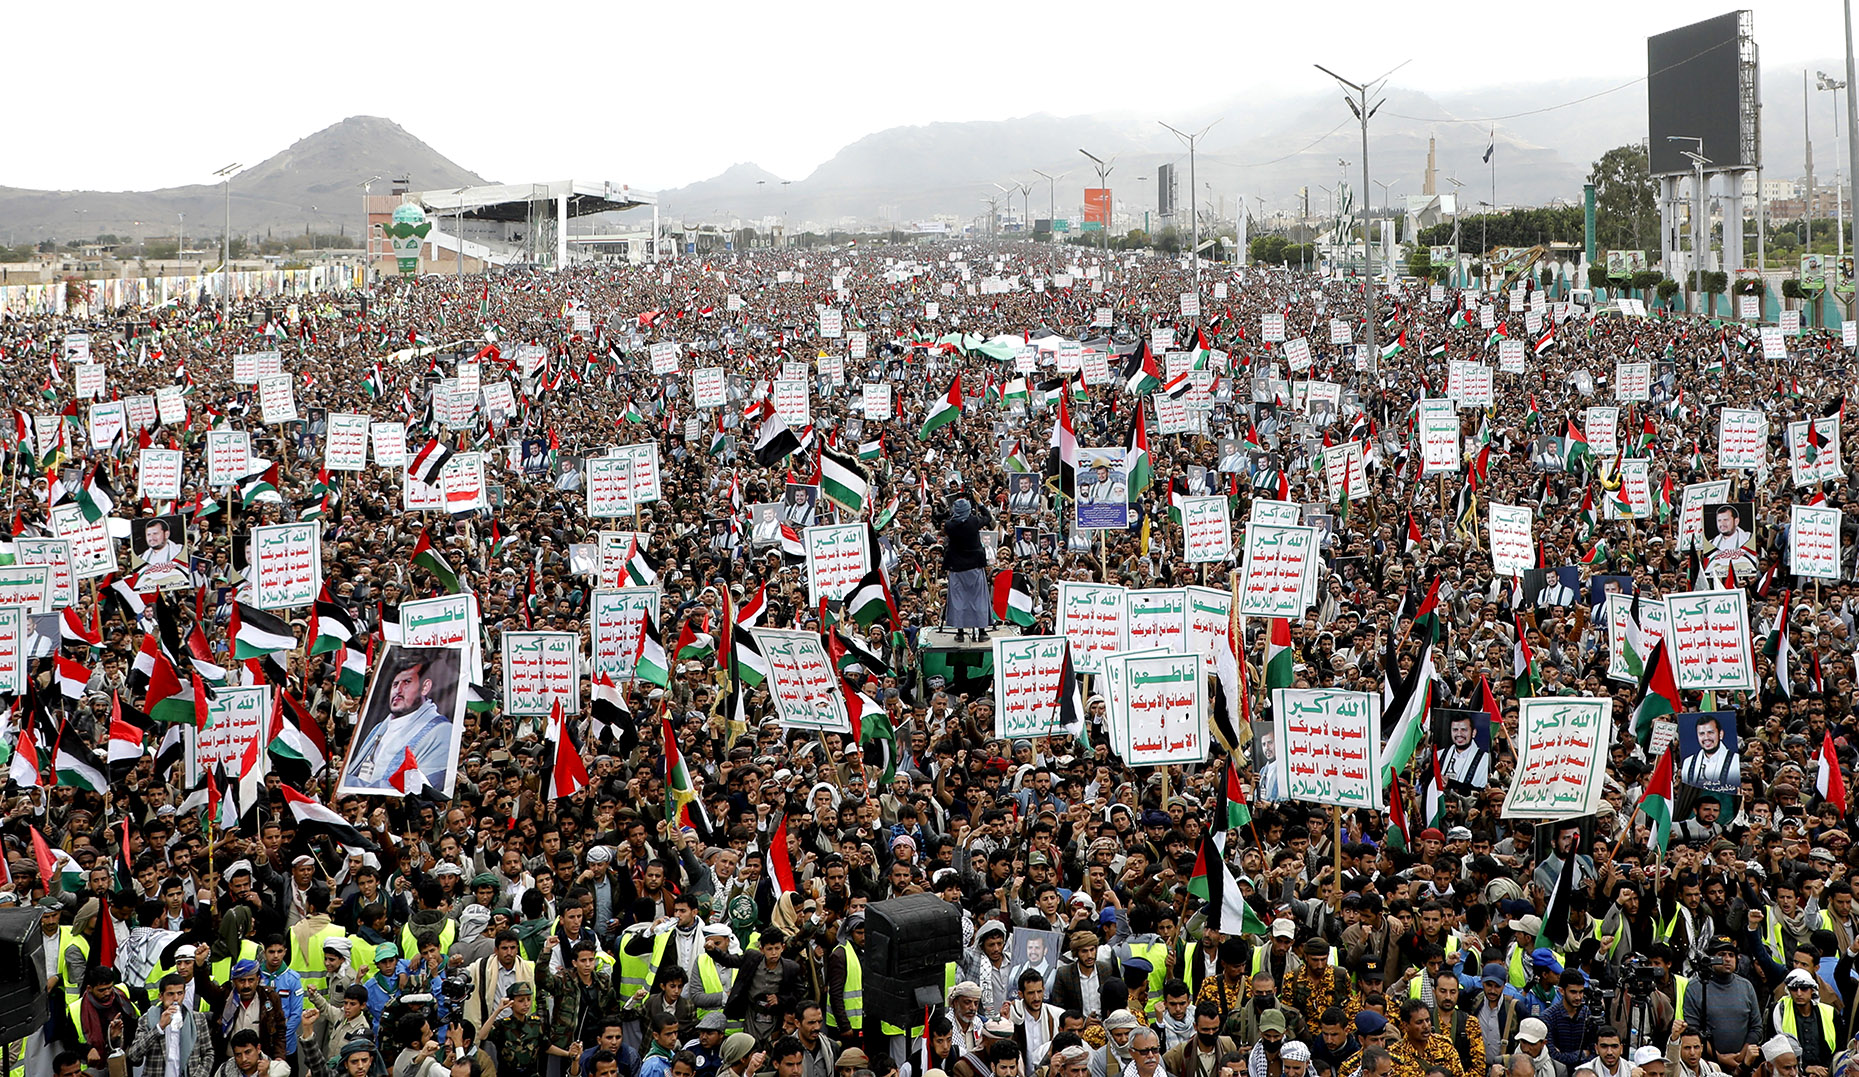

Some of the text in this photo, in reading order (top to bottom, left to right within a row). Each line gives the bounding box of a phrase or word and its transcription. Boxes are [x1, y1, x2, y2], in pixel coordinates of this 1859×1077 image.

[1280, 509, 1294, 518] الله
[260, 529, 311, 549] الله أكبر
[814, 530, 861, 550] الله أكبر
[1254, 530, 1309, 549] الله أكبر
[290, 546, 311, 557] الموت
[842, 547, 862, 558] الموت
[1282, 553, 1305, 563] الموت
[291, 559, 312, 571] الموت
[843, 560, 863, 571] الموت
[1280, 569, 1303, 578] الموت
[262, 573, 312, 589] اللعنة على اليهود
[1248, 582, 1300, 593] اللعنة على اليهود
[291, 585, 313, 602] النصر
[1068, 589, 1120, 608] الله أكبر
[599, 595, 631, 616] أكبر
[1130, 598, 1182, 618] قاطعوا
[1190, 595, 1230, 616] اطعوا
[1244, 596, 1298, 612] النصر للإسلام
[1675, 598, 1737, 620] الله أكبر
[406, 604, 464, 631] قاطعوا
[1097, 612, 1119, 622] الموت
[1096, 627, 1119, 637] الموت
[1712, 621, 1738, 633] الموت
[512, 637, 571, 654] الله أكبر
[770, 640, 819, 657] الله أكبر
[1041, 643, 1063, 657] الله
[1087, 640, 1118, 651] اللعنة على
[1714, 638, 1740, 651] الموت
[1005, 642, 1040, 665] أكبر
[1680, 653, 1742, 666] اللعنة على اليهود
[546, 657, 571, 666] الموت
[802, 660, 825, 671] الموت
[546, 670, 571, 680] الموت
[806, 673, 830, 686] الموت
[1130, 664, 1194, 689] قاطعوا
[1682, 667, 1744, 685] النصر للإسلام
[513, 684, 571, 694] اللعنة على اليهود
[237, 694, 260, 709] الله
[513, 696, 542, 712] للإسلام
[1006, 699, 1028, 713] اليهود
[1031, 699, 1042, 711] على
[1166, 692, 1194, 710] البضائع
[1288, 693, 1366, 718] الله أكبر
[233, 715, 260, 728] الموت
[1160, 714, 1165, 729] و
[1530, 707, 1597, 735] الله أكبر
[1332, 726, 1366, 740] الموت
[1564, 736, 1593, 748] الموت
[223, 750, 236, 763] على
[1333, 747, 1366, 760] الموت
[1561, 754, 1590, 768] الموت
[1291, 762, 1367, 780] اللعنة على اليهود
[1521, 769, 1587, 786] اللعنة على اليهود
[1292, 780, 1369, 801] النصر للإسلام
[1513, 788, 1583, 807] النصر للإسلام
